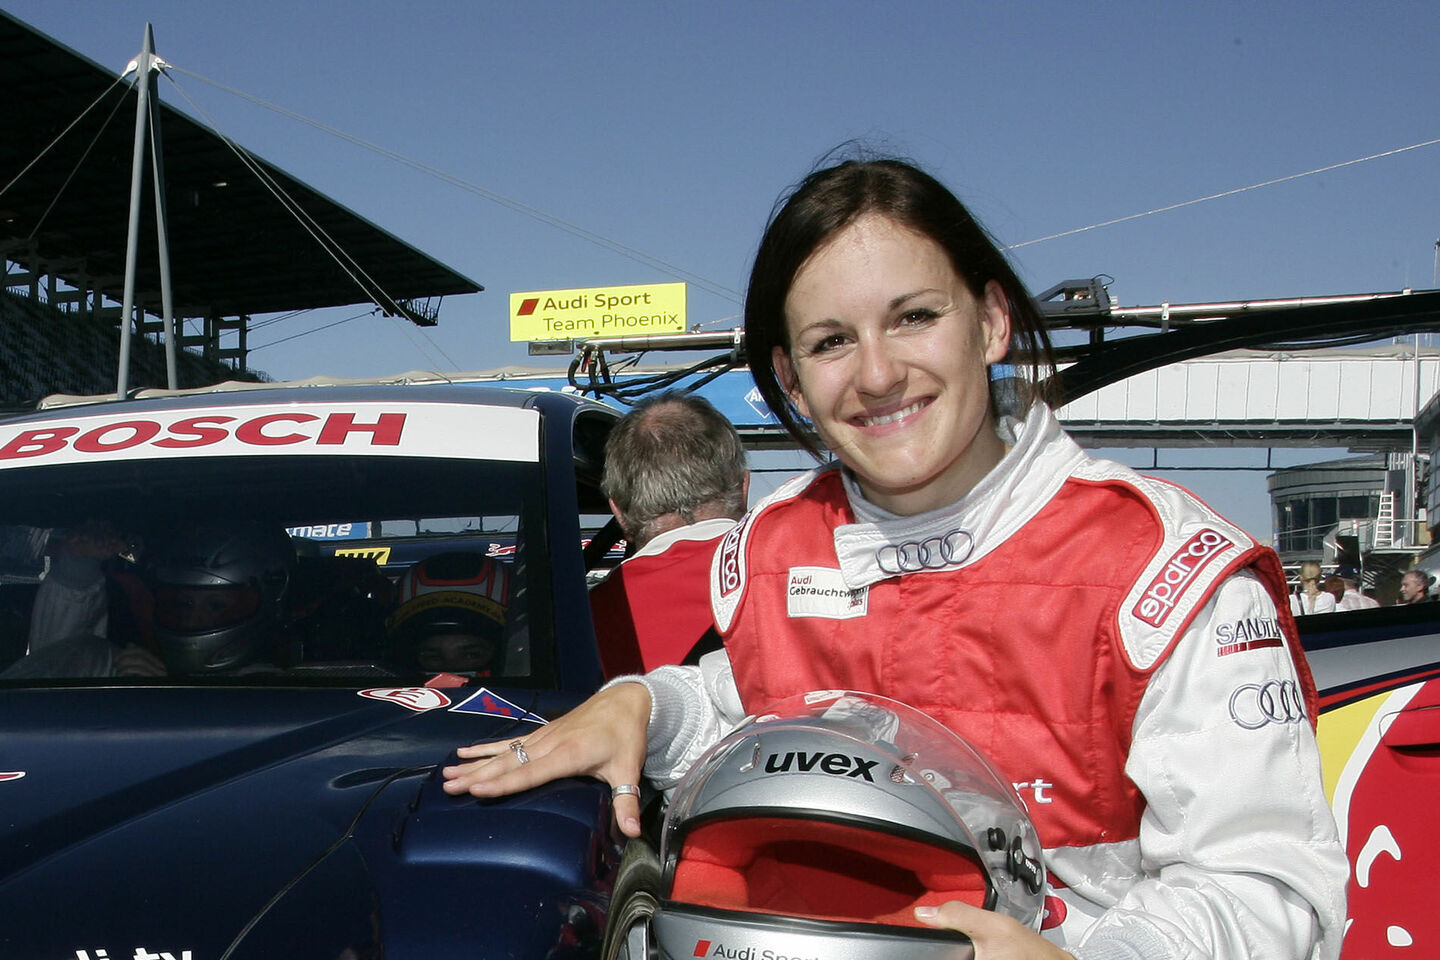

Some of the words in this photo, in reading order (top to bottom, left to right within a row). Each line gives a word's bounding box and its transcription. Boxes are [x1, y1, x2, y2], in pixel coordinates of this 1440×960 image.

[543, 295, 588, 312] Audi
[594, 291, 652, 310] Sport
[543, 316, 595, 332] Team
[602, 311, 679, 329] Phoenix
[791, 575, 813, 585] Audi
[1140, 531, 1224, 619] sparco
[764, 752, 880, 783] uvex
